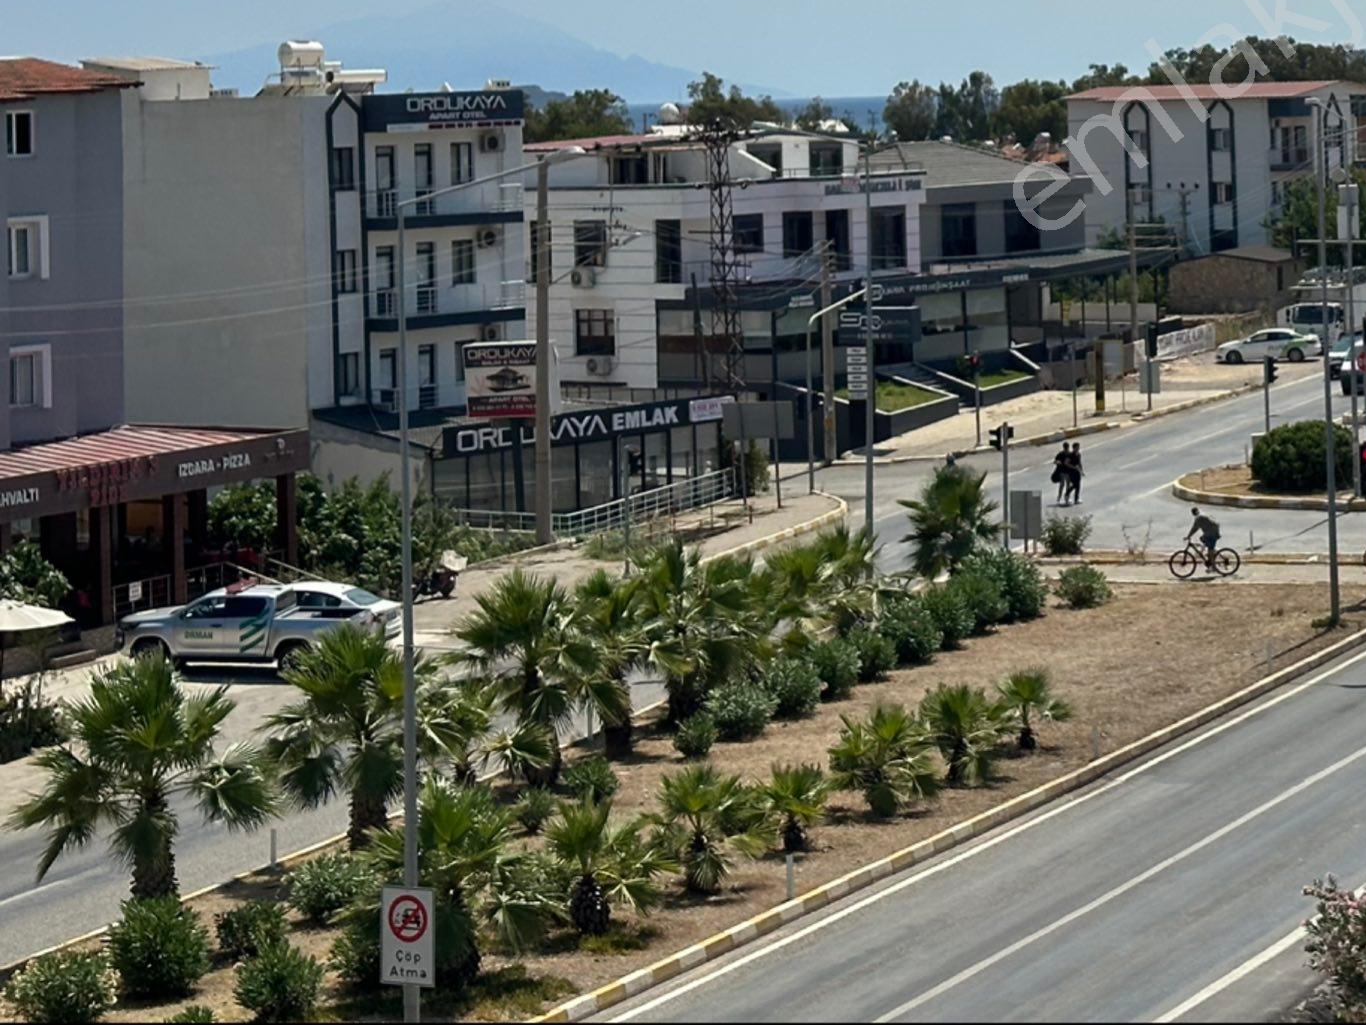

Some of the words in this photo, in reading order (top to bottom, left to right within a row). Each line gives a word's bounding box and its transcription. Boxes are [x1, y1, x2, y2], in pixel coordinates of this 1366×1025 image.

[406, 95, 507, 113] ORDUKAYA
[429, 111, 461, 121] APART
[462, 110, 487, 119] OTEL
[612, 405, 680, 432] EMLAK
[395, 950, 421, 964] Çöp
[390, 965, 427, 979] Atma
